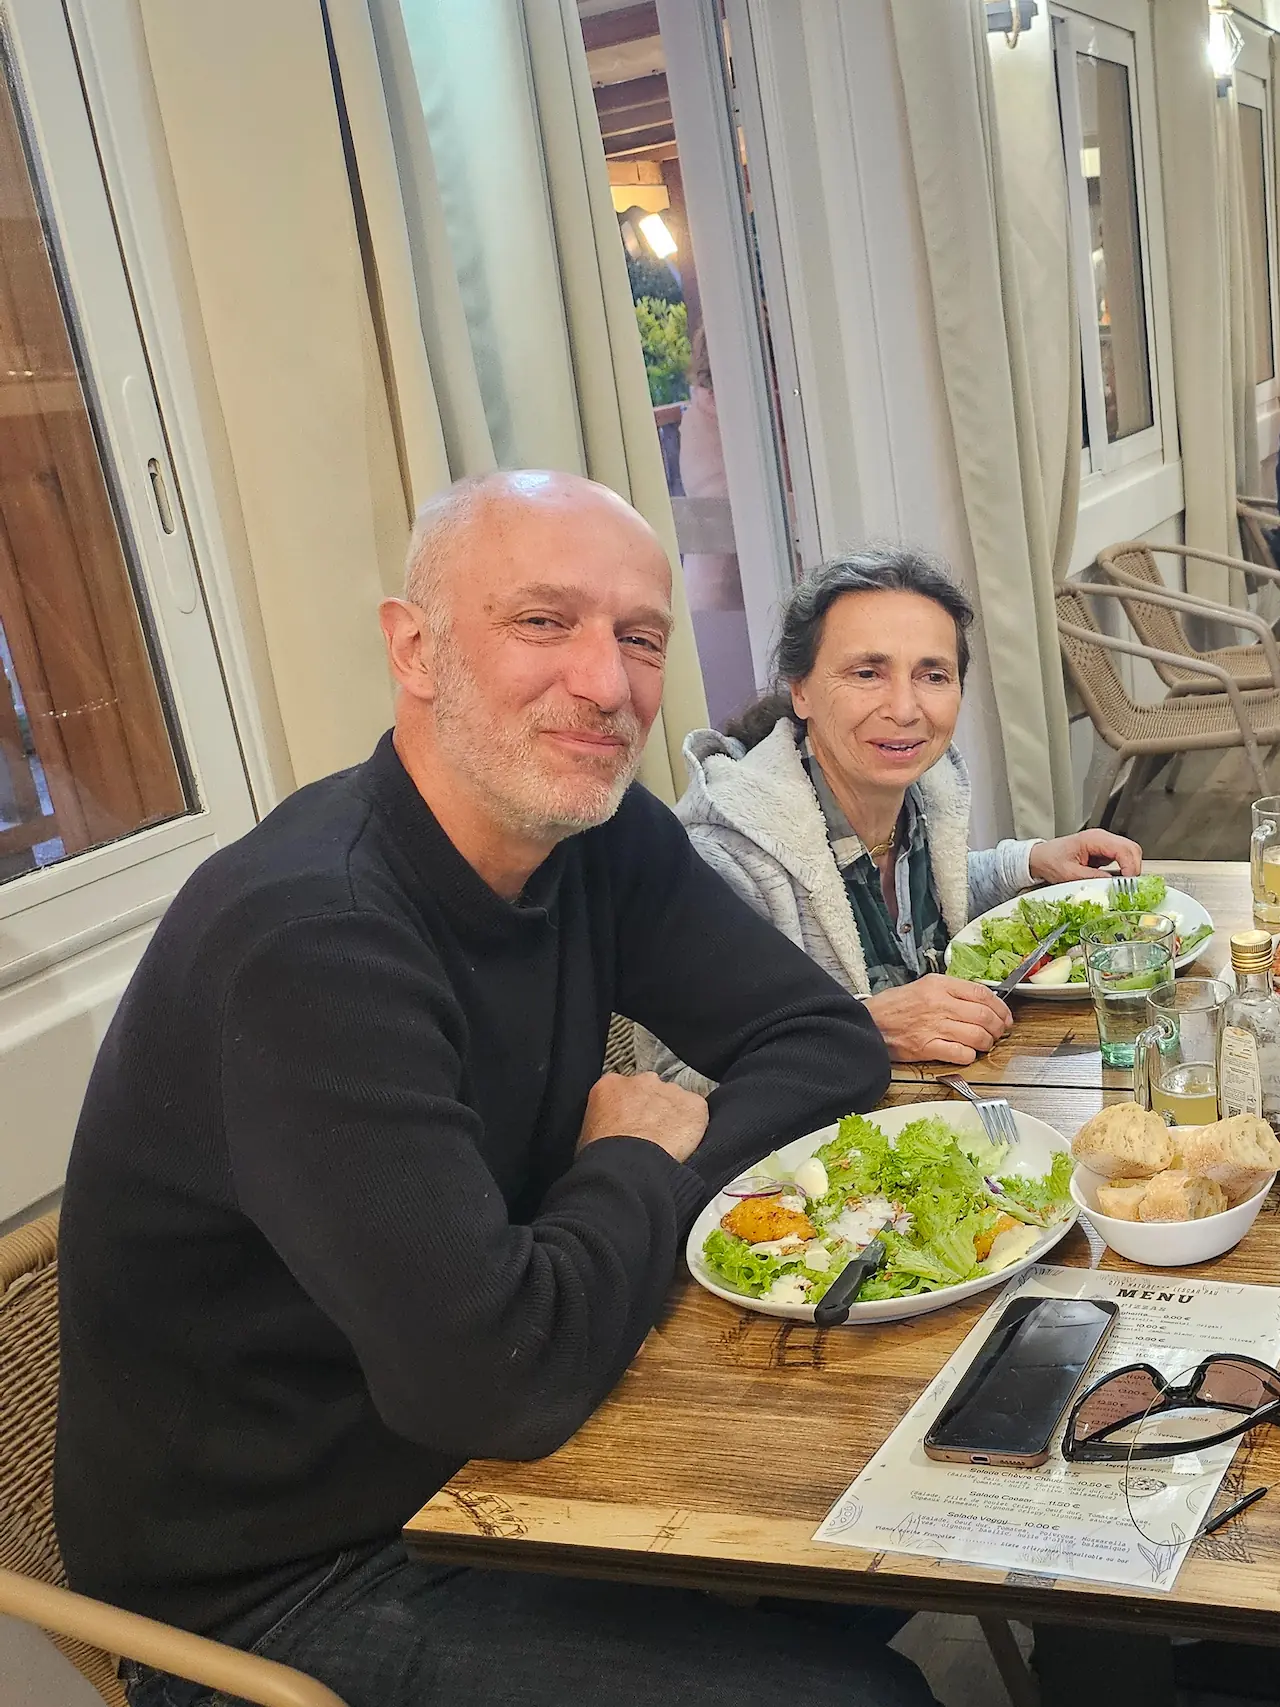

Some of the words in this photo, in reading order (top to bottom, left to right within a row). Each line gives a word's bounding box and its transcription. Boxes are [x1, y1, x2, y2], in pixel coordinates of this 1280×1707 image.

[1115, 1288, 1195, 1304] MENU
[969, 1467, 999, 1476] Salade
[1078, 1480, 1103, 1489] 10.50
[969, 1490, 1000, 1499] Salade
[1049, 1500, 1071, 1508] 11.50
[946, 1511, 979, 1521] Salade
[980, 1516, 1009, 1525] Veggy
[1024, 1521, 1050, 1530] 10.00
